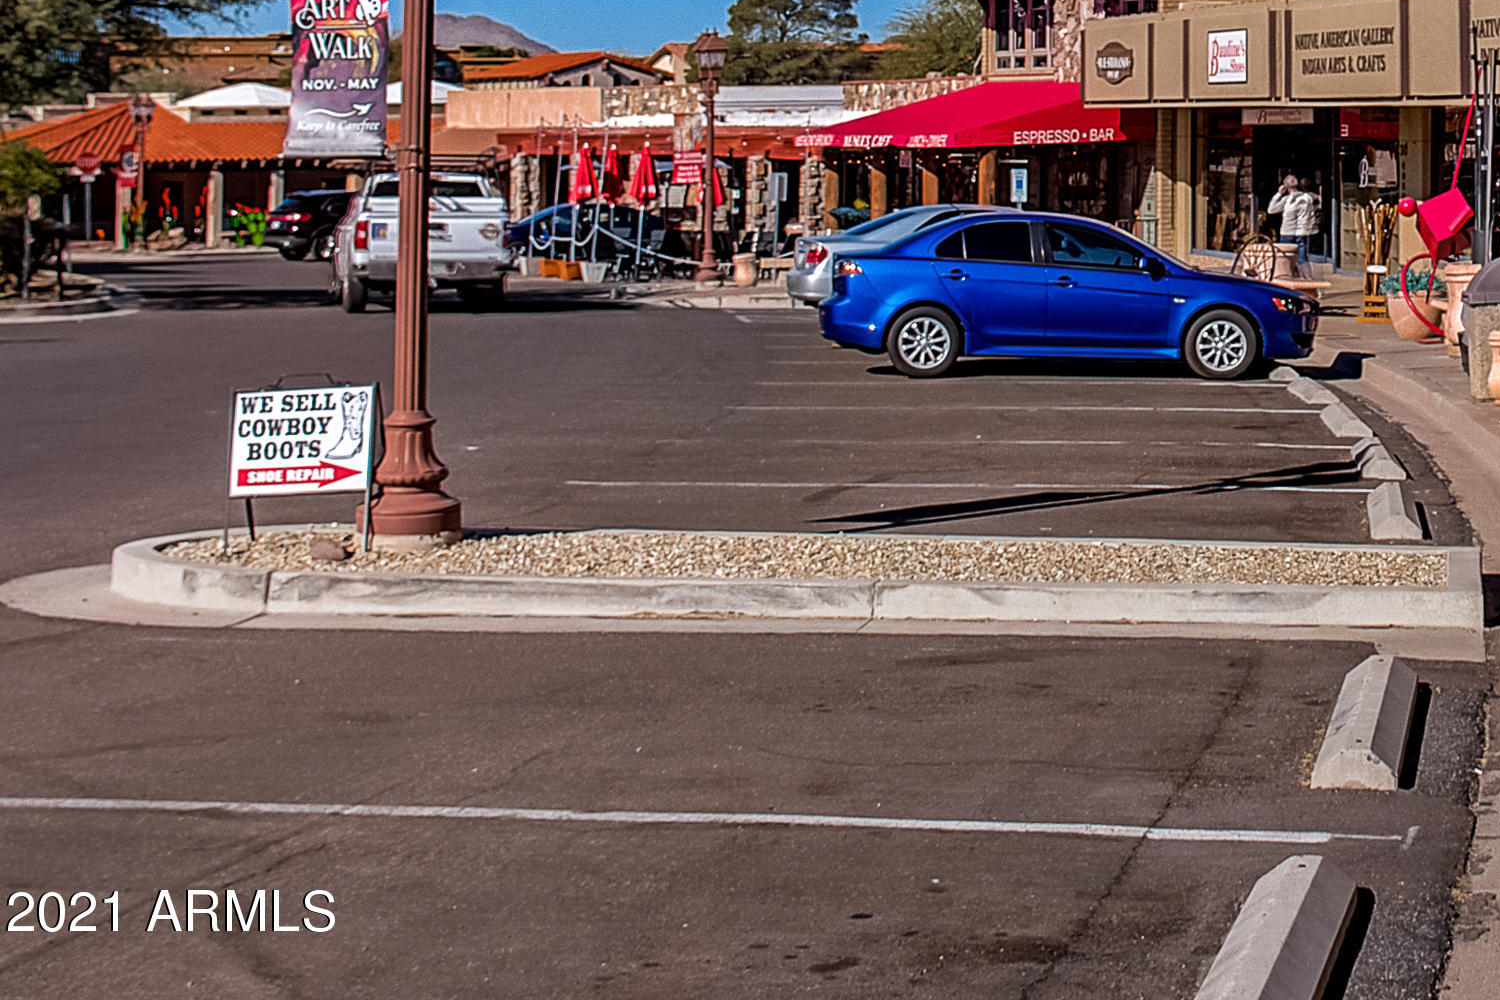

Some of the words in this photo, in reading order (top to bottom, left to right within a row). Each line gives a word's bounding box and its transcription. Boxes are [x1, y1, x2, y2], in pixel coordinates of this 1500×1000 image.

[308, 31, 373, 60] WALK
[1295, 33, 1319, 50] NATIVE
[1320, 29, 1360, 49] AMERICAN
[1361, 26, 1395, 45] GALLERY
[1302, 57, 1328, 75] INDIAN
[1356, 54, 1386, 72] CRAFTS
[301, 78, 337, 91] NOV.
[347, 78, 379, 91] MAY
[338, 118, 380, 135] Carefree
[1013, 129, 1080, 145] ESPRESSO
[1089, 128, 1114, 141] BAR
[241, 396, 274, 414] WE
[281, 393, 337, 412] SELL
[238, 416, 333, 437] COWBOY
[247, 440, 322, 461] BOOTS
[247, 470, 283, 483] SHOE
[286, 468, 335, 483] REPAIR
